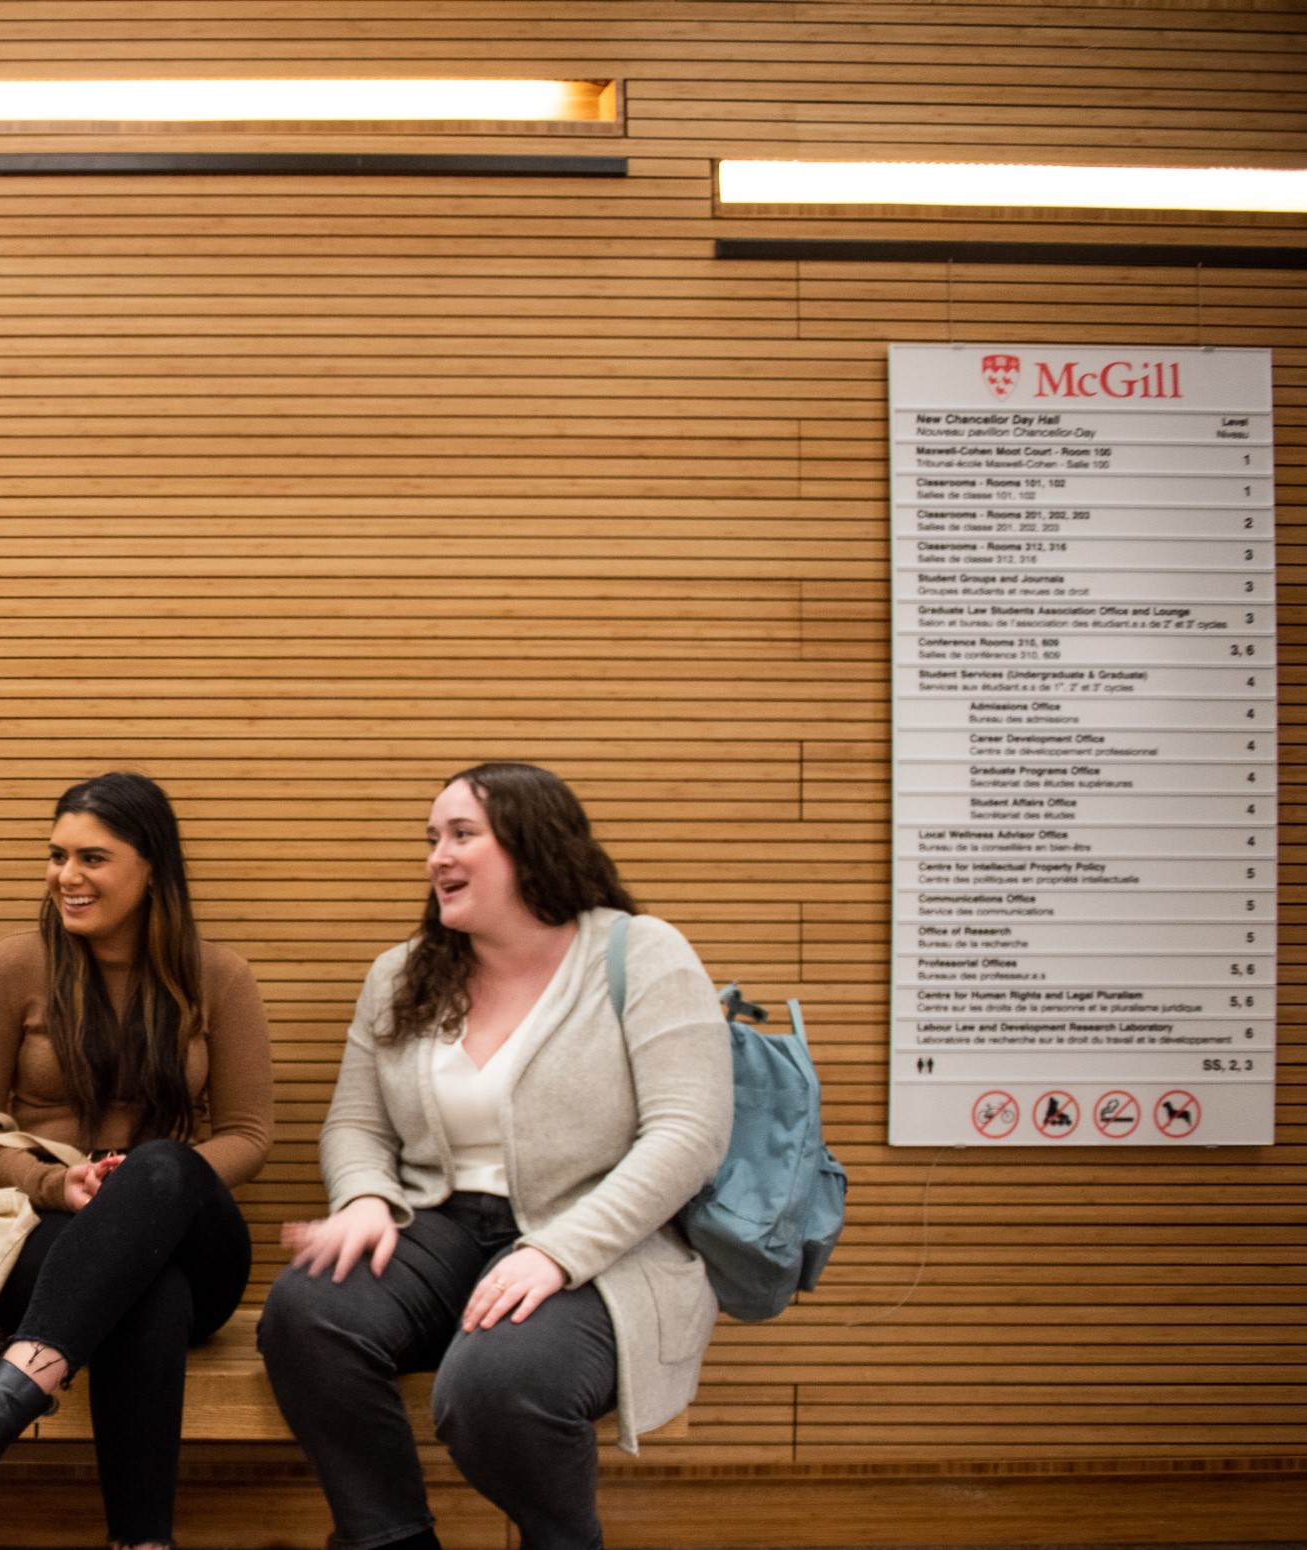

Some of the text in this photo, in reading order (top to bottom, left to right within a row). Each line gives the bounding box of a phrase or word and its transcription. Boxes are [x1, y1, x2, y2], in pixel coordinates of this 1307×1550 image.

[1034, 361, 1183, 399] McGill
[1244, 454, 1250, 464] 1
[1244, 486, 1250, 496] 1
[1244, 517, 1253, 528] 2
[1245, 549, 1253, 560] 3
[1245, 581, 1254, 592] 3
[1246, 612, 1254, 623] 3
[1231, 644, 1254, 657] 3, 6
[1247, 676, 1255, 686] 4
[1247, 708, 1254, 718] 4
[1247, 740, 1255, 750] 4
[1247, 772, 1255, 782] 4
[1247, 804, 1255, 814] 4
[1247, 836, 1255, 846] 4
[1247, 867, 1255, 878] 5
[1246, 900, 1255, 910] 5
[1246, 932, 1254, 942] 5
[1231, 963, 1255, 976] 5, 6
[1230, 996, 1254, 1008] 5, 6
[1245, 1027, 1254, 1038] 6
[1203, 1059, 1253, 1072] SS, 2, 3
